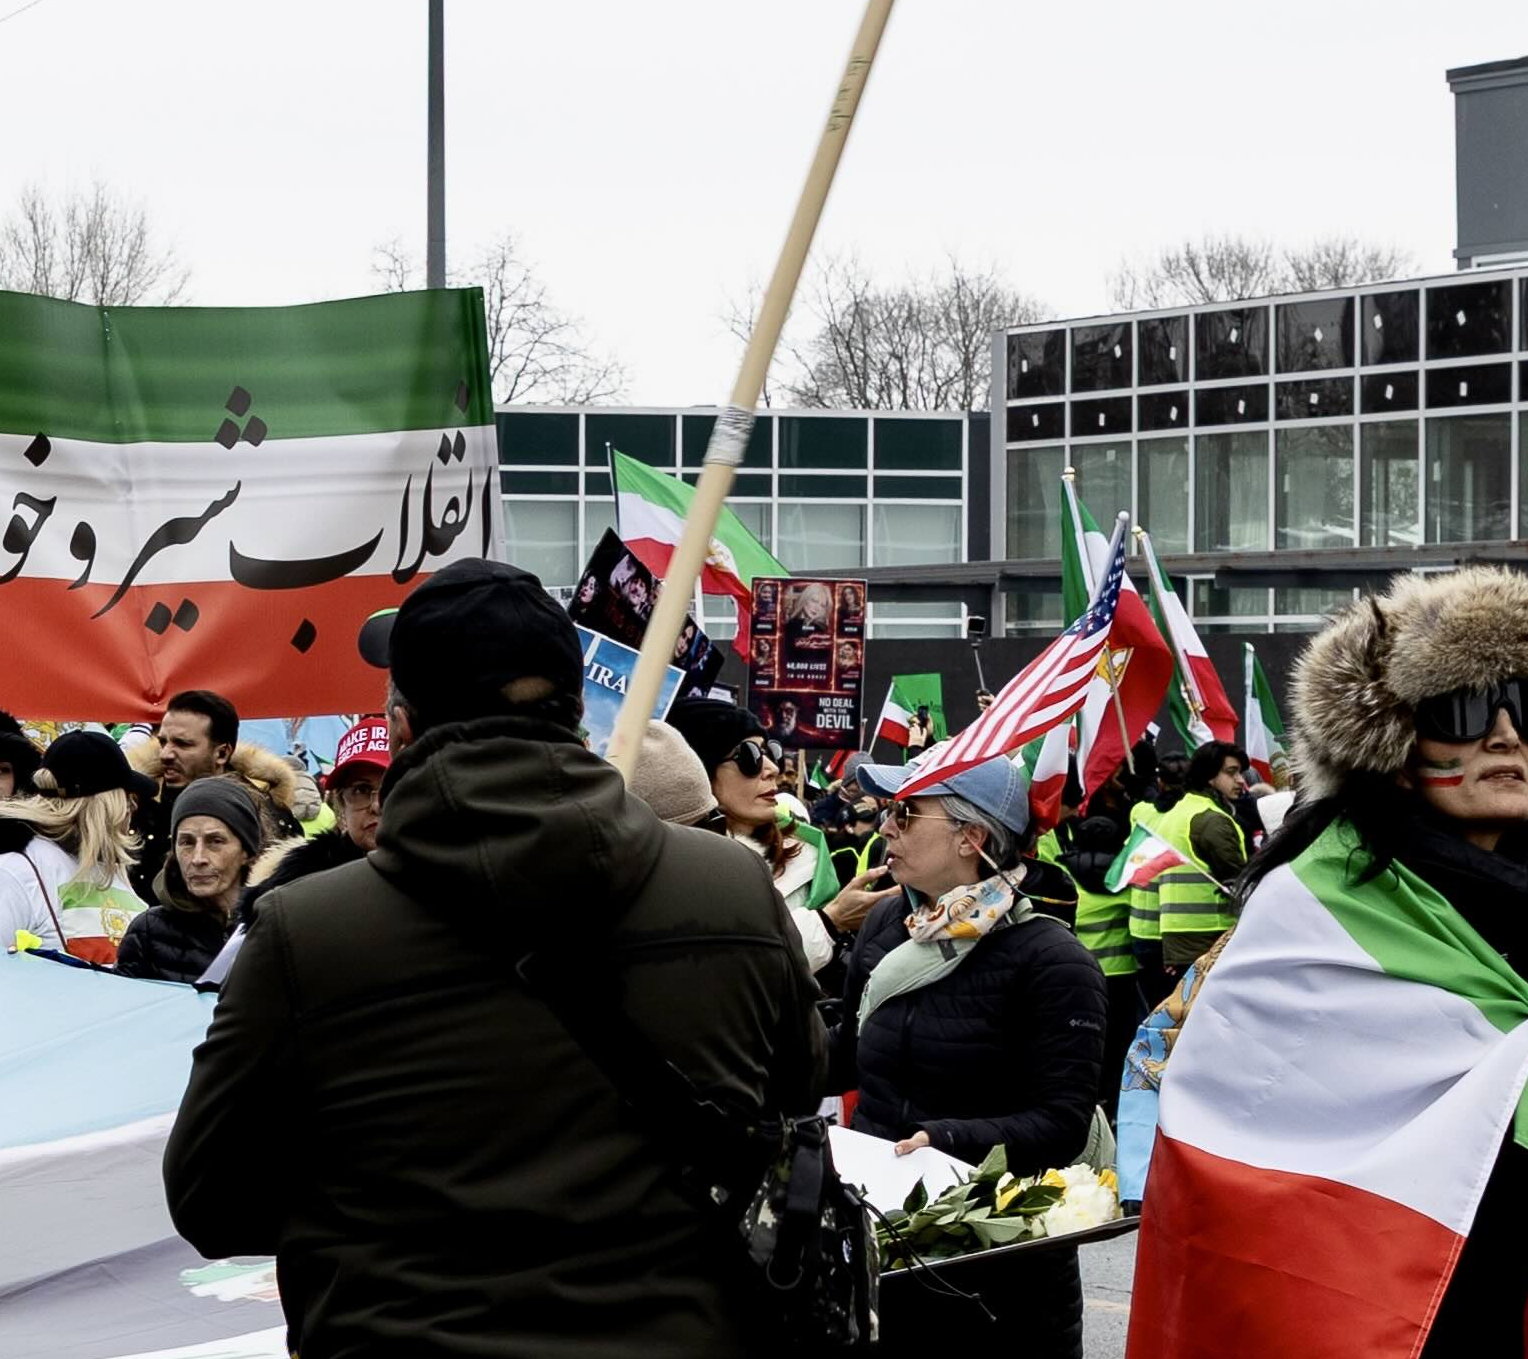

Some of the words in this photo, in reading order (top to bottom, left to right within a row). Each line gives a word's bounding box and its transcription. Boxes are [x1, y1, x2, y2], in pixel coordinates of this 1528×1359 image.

[586, 662, 628, 694] IRA
[819, 697, 832, 707] NO
[833, 697, 854, 708] DEAL
[816, 714, 854, 729] DEVIL
